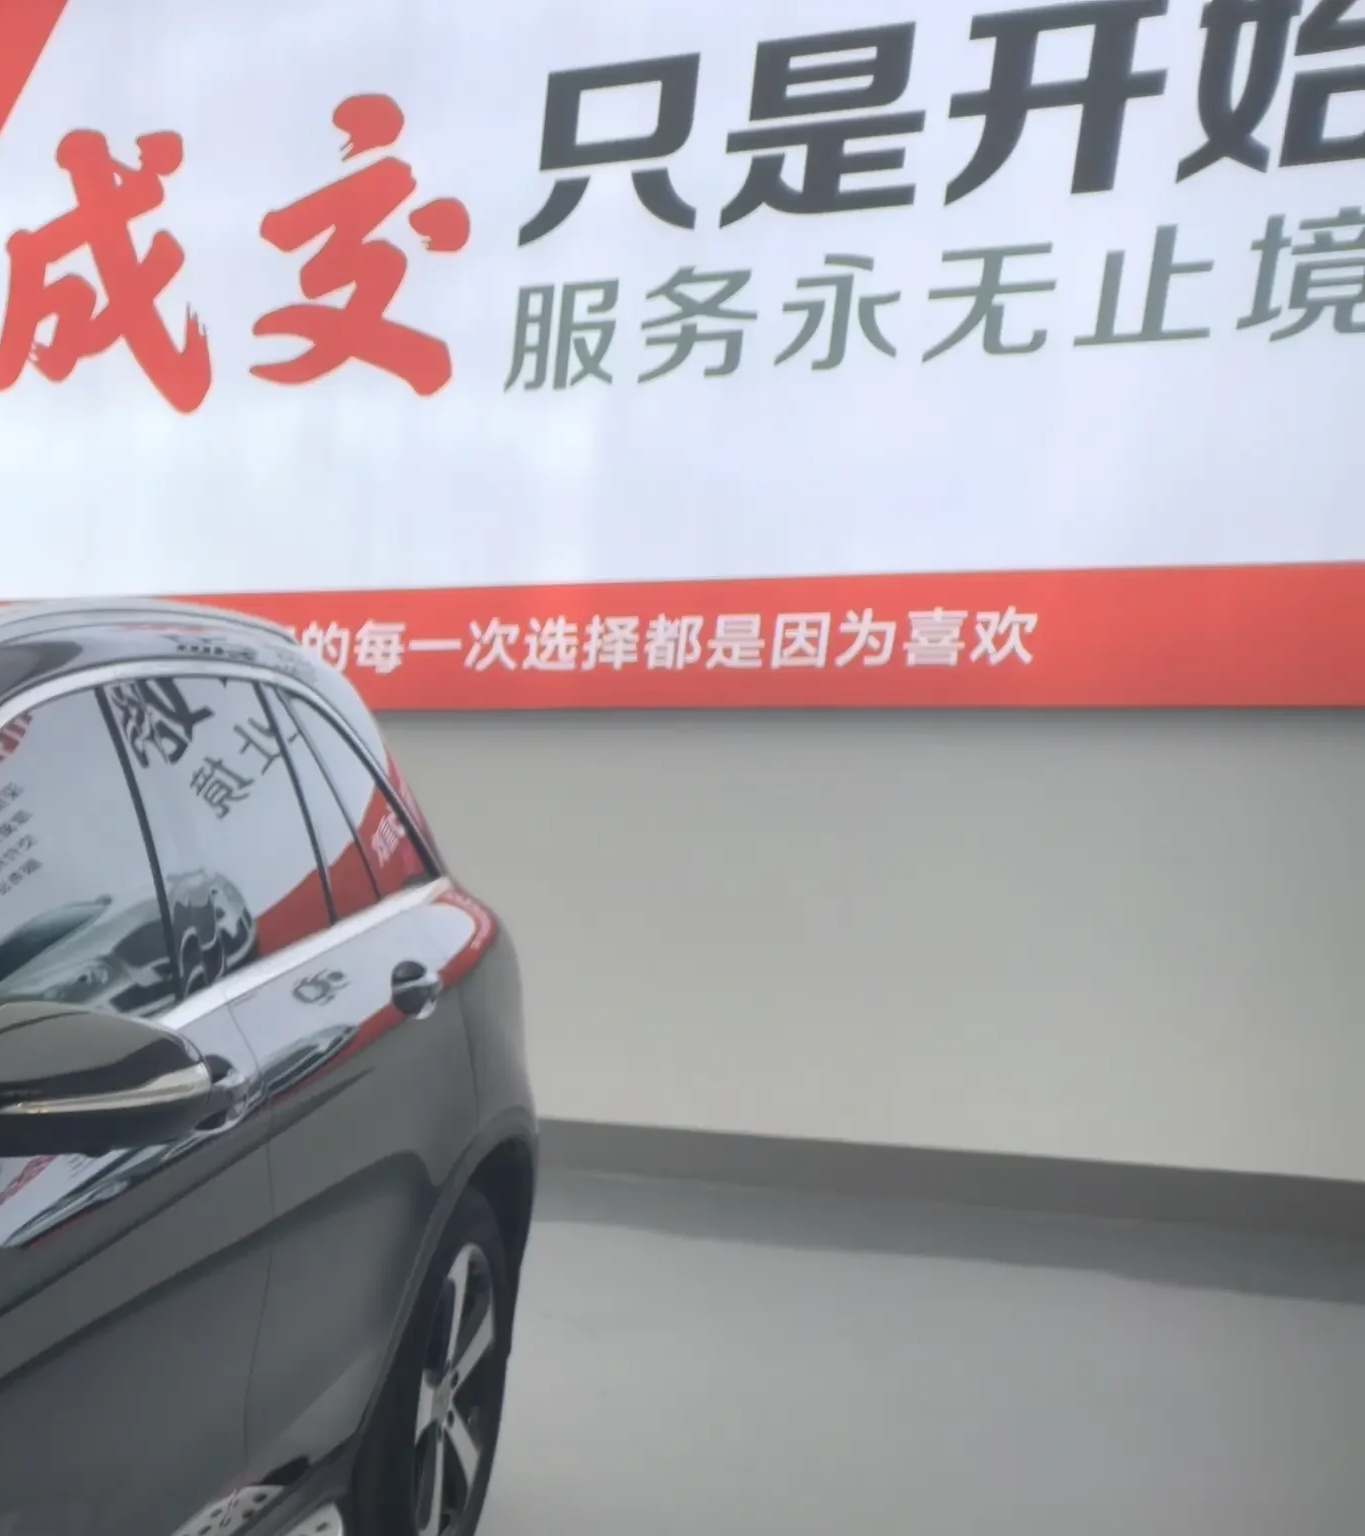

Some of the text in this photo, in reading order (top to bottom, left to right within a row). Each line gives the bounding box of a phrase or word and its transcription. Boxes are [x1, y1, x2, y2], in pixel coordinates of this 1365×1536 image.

[517, 0, 1365, 248] 只是开始
[503, 205, 1365, 394] 服务永无止境
[287, 606, 1040, 675] 的每一次选择都是因为喜欢
